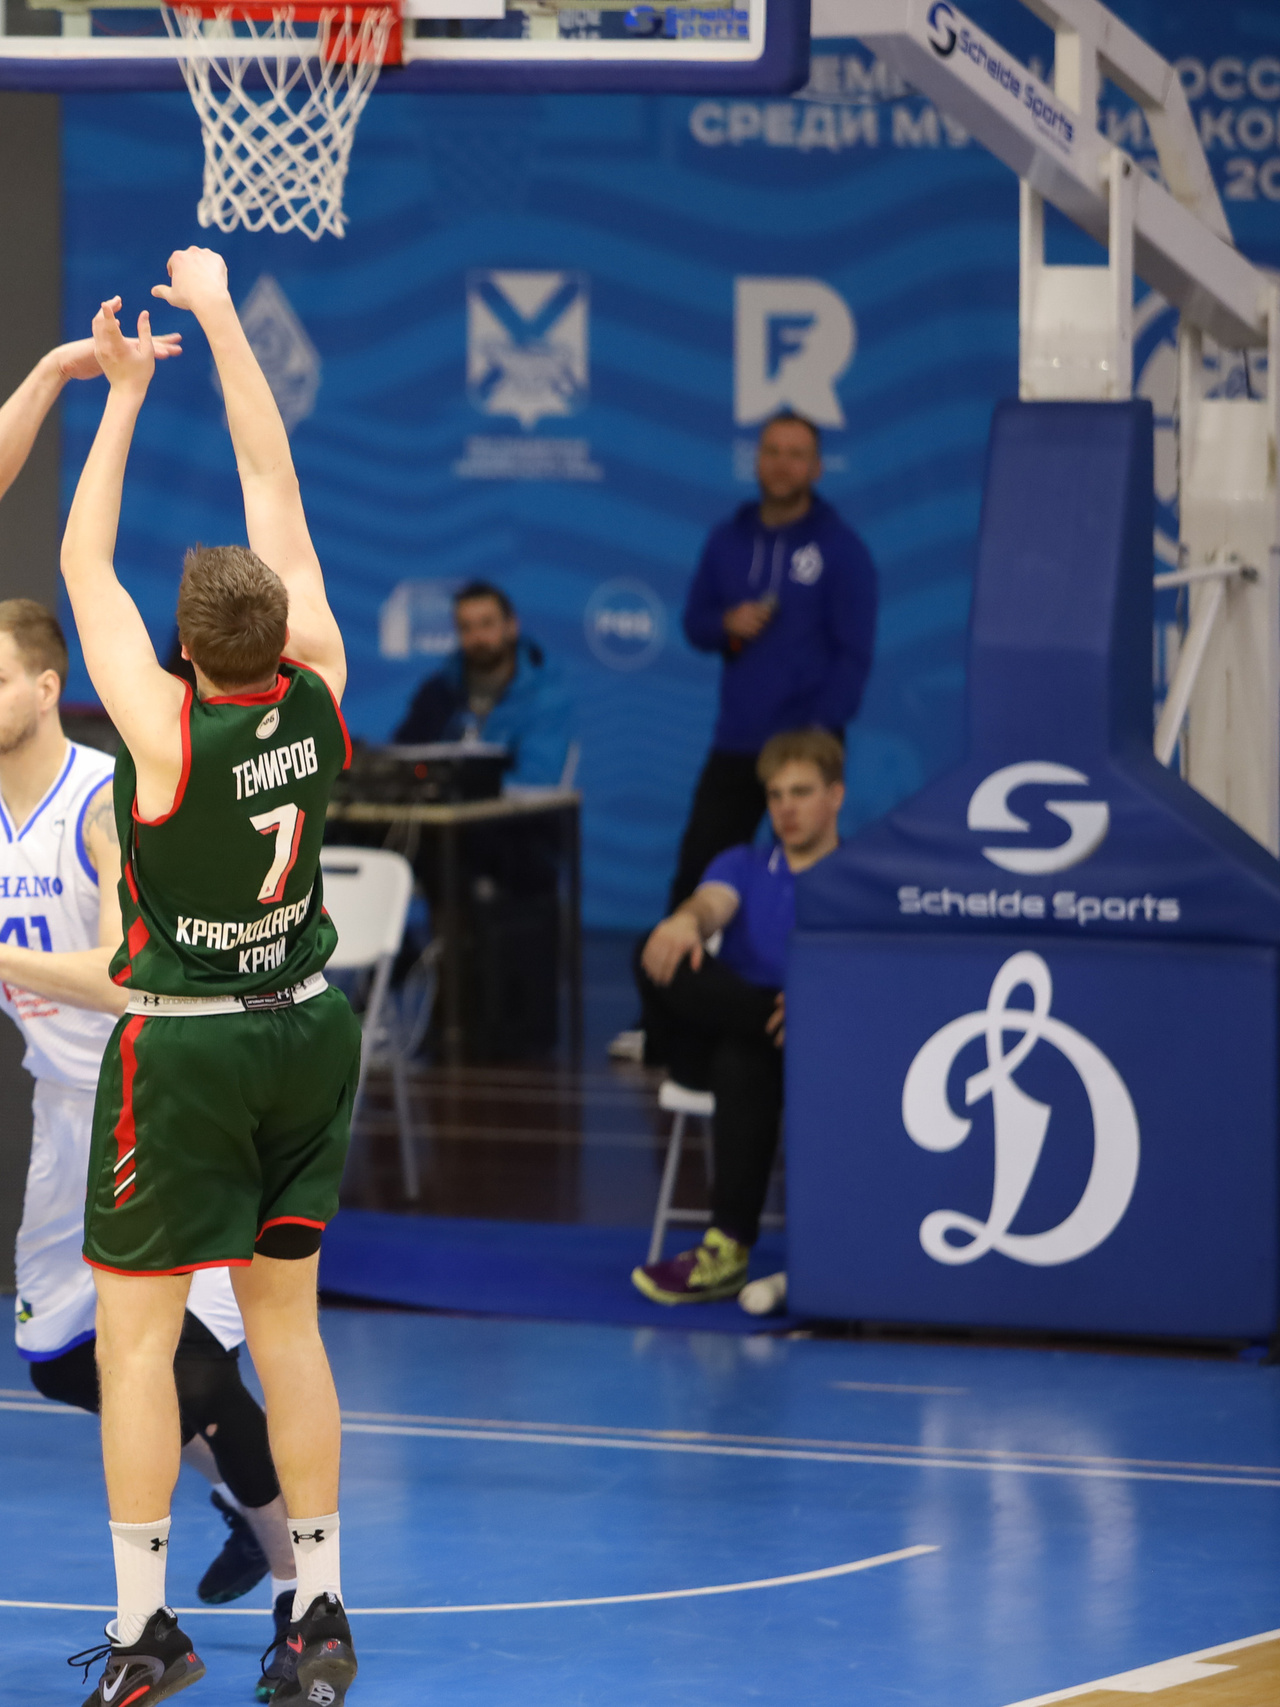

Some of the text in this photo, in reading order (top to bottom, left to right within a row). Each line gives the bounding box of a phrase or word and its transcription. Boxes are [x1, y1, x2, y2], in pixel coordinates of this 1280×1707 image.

[958, 27, 1021, 99] Schelde
[1023, 82, 1074, 144] Sports
[689, 101, 878, 150] СРЕДИ
[232, 736, 319, 801] ТЕМИРОВ
[249, 802, 305, 904] 7
[898, 886, 1180, 926] Schelde Sports
[238, 936, 286, 974] КРАЙ
